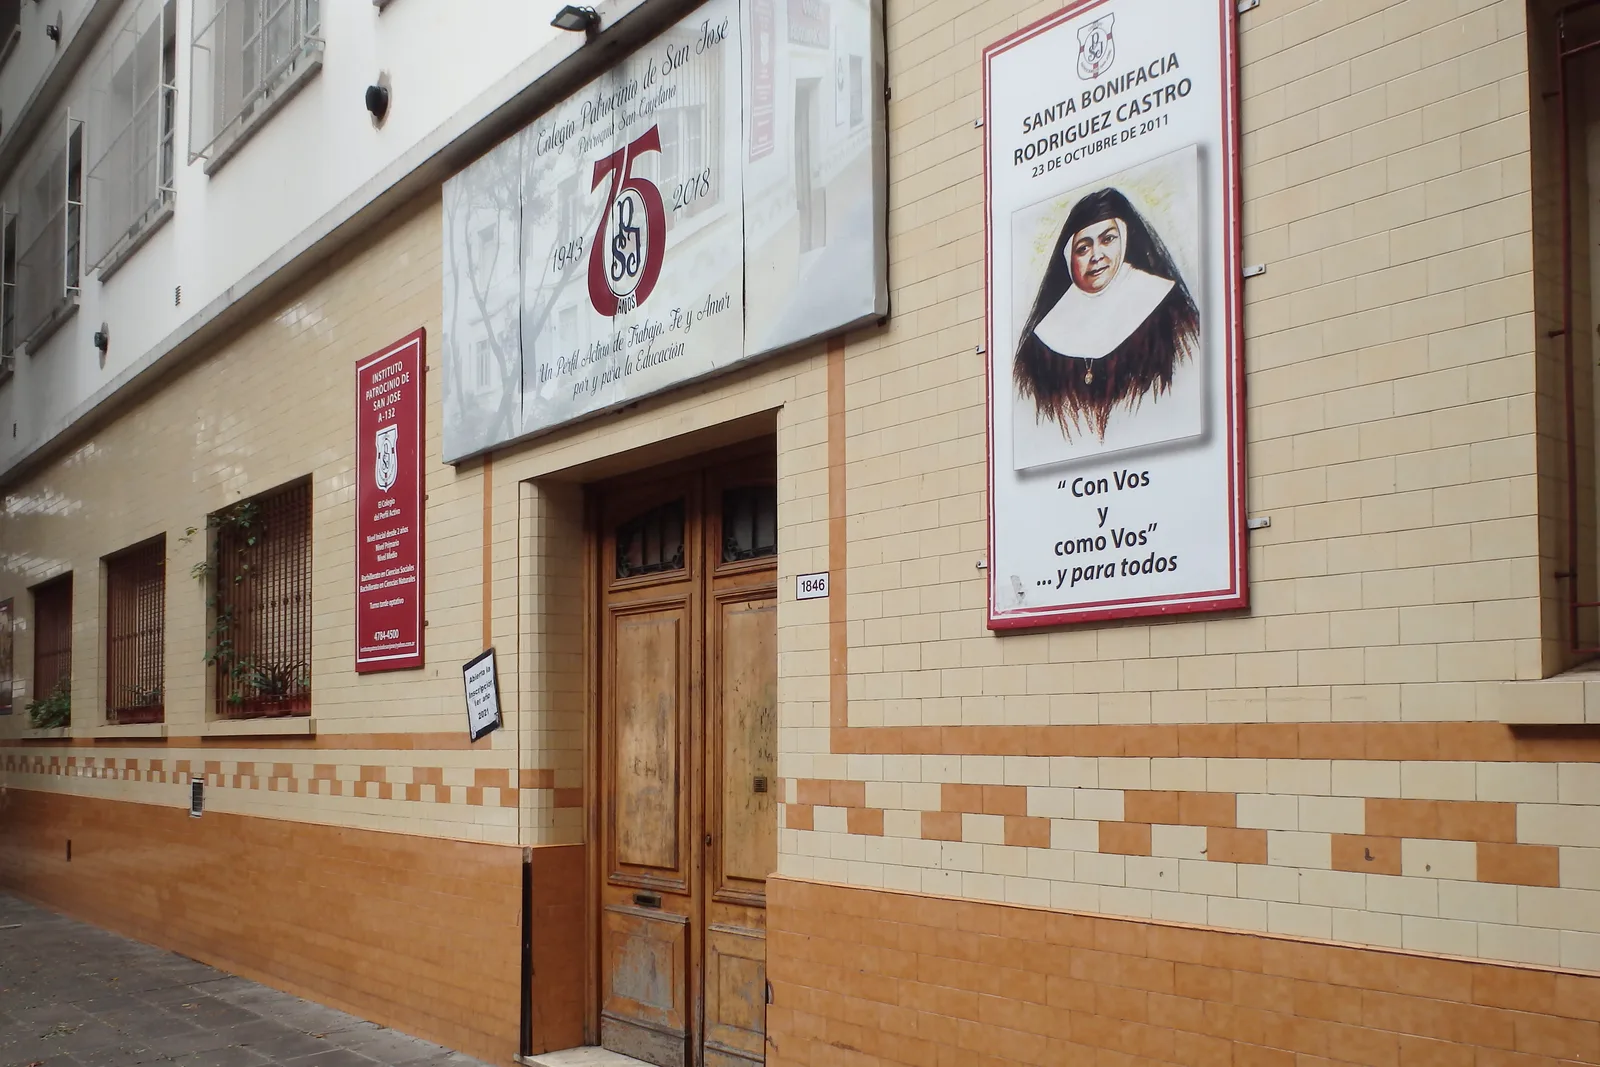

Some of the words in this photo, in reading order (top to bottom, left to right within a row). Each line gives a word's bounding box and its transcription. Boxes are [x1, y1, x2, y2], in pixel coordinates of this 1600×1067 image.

[536, 120, 575, 157] Colegio
[580, 79, 638, 131] Patrocinio
[643, 57, 657, 90] de
[661, 43, 690, 76] San
[695, 16, 729, 55] José
[1022, 98, 1076, 134] SANTA
[1081, 52, 1180, 110] BONIFACIA
[618, 110, 636, 131] San
[638, 84, 677, 119] Cayetano
[1013, 110, 1112, 167] RODRIGUEZ
[1116, 77, 1192, 123] CASTRO
[1031, 164, 1045, 179] 23
[1047, 156, 1062, 173] DE
[1064, 134, 1118, 165] OCTUBRE
[1120, 126, 1137, 143] DE
[1139, 114, 1170, 136] 2011
[672, 168, 711, 212] 2018
[552, 236, 584, 273] 1943
[539, 363, 553, 384] Un
[556, 346, 578, 377] Perfil
[613, 330, 624, 352] de
[669, 308, 683, 332] Fe
[684, 313, 693, 334] y
[696, 291, 731, 321] Amor
[365, 377, 401, 401] PATROCINIO
[401, 371, 410, 383] DE
[372, 361, 402, 384] INSTITUTO
[572, 375, 589, 401] por
[590, 377, 599, 397] y
[601, 366, 621, 391] para
[624, 355, 633, 376] la
[635, 341, 685, 372] Educación
[373, 397, 386, 411] SAN
[386, 390, 401, 406] JOSE
[377, 407, 396, 423] A-132
[1071, 477, 1108, 498] Con
[1113, 469, 1150, 491] Vos
[1097, 506, 1109, 528] y
[1054, 535, 1107, 557] como
[801, 579, 825, 592] 1846
[1055, 568, 1067, 590] y
[1070, 562, 1116, 588] para
[1120, 552, 1178, 577] todos
[469, 669, 486, 684] Abierta
[477, 708, 490, 720] 2021
